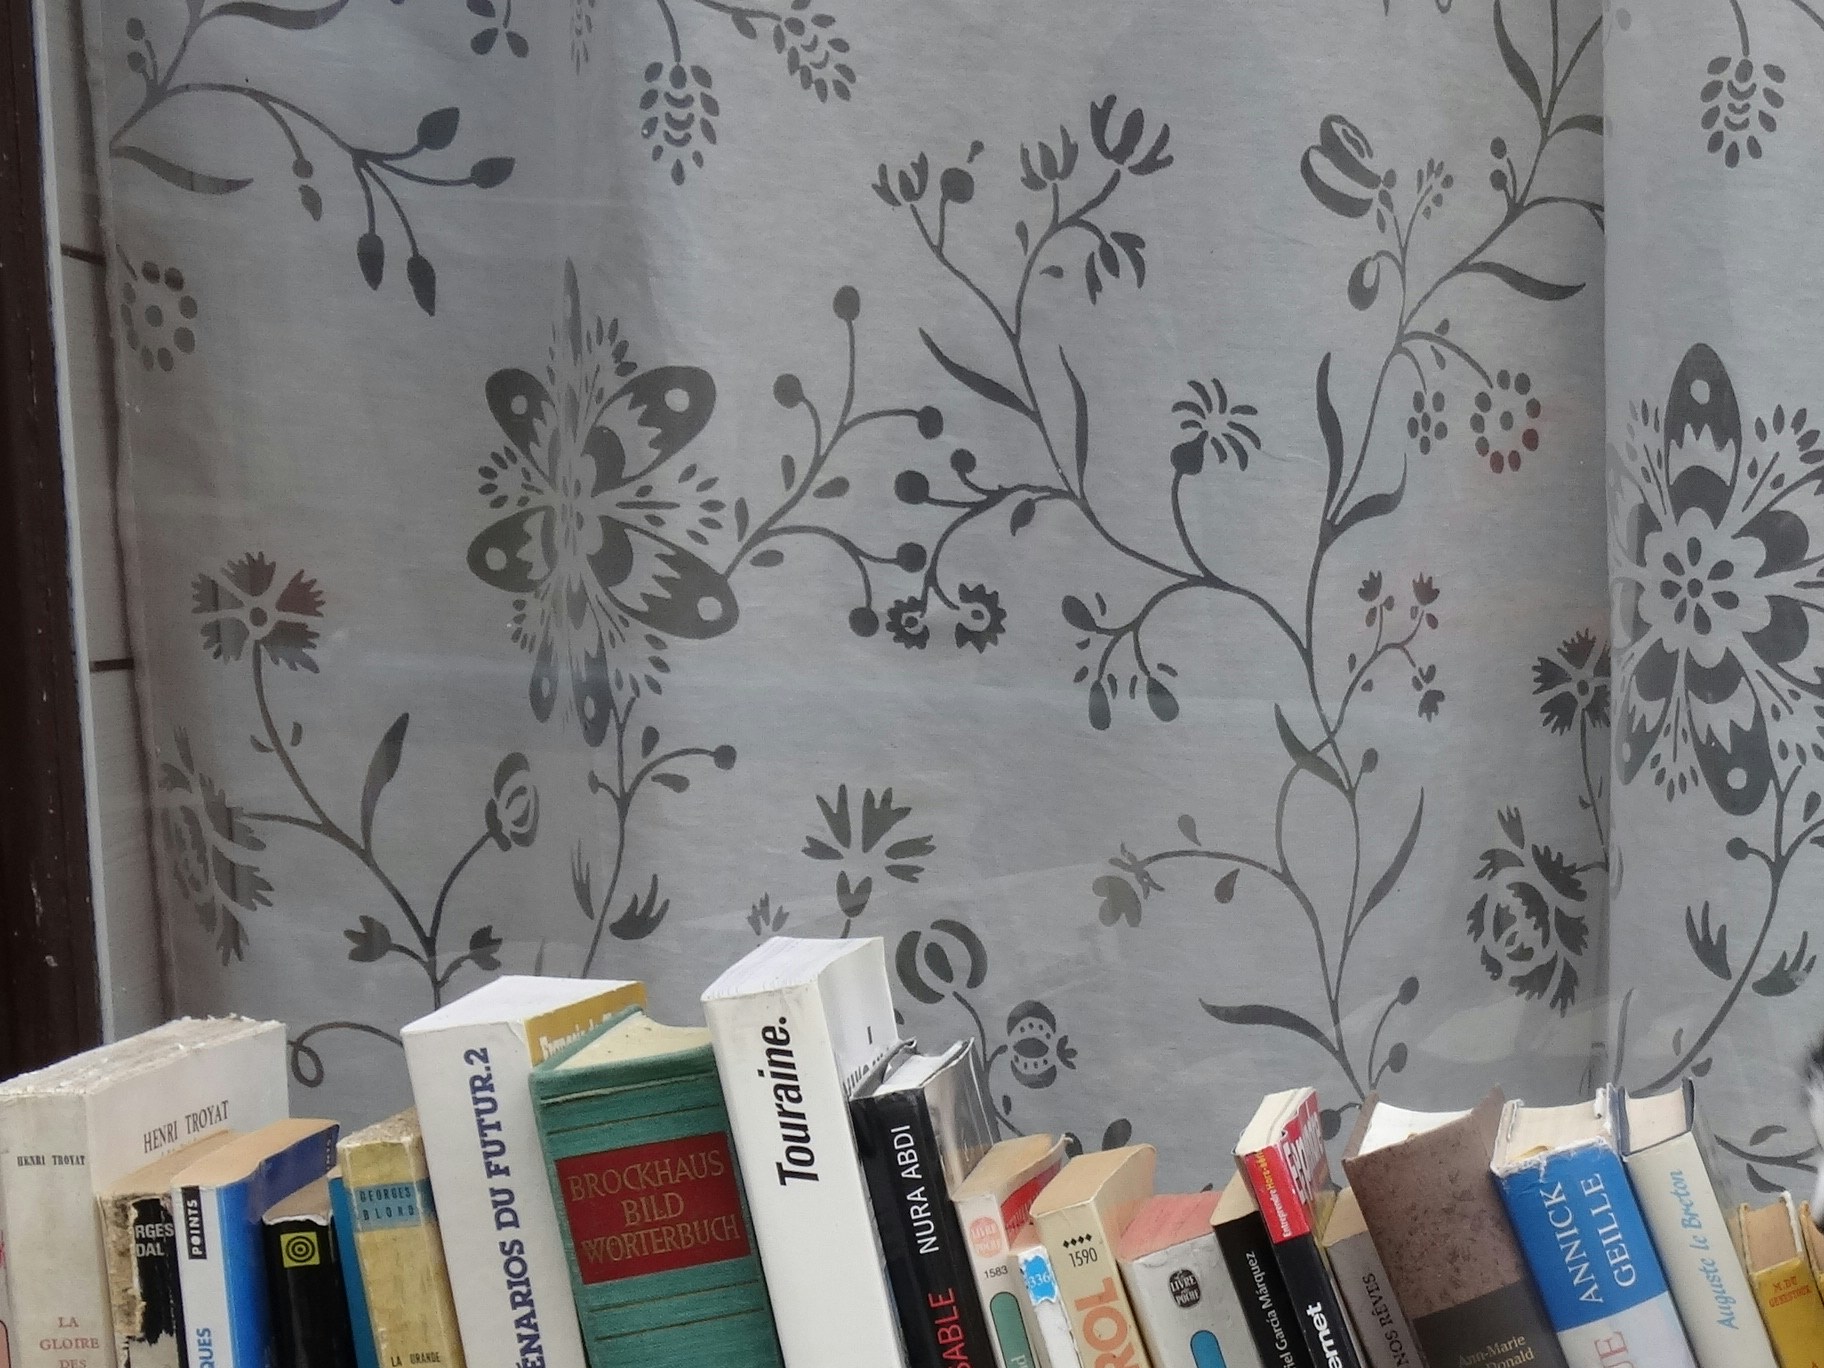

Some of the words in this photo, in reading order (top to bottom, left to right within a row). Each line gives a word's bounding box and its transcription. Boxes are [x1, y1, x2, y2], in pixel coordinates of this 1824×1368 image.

[143, 1120, 178, 1154] HENRI
[184, 1100, 229, 1142] TROYAT
[464, 1047, 510, 1179] FUTUR.2
[758, 1015, 820, 1186] Touraine.
[17, 1155, 46, 1167] HENRI
[52, 1154, 86, 1166] TROYAT
[567, 1150, 724, 1202] BROCKHAUS
[891, 1125, 923, 1179] ABDI
[360, 1186, 411, 1202] GEORGES
[485, 1181, 520, 1231] DU
[622, 1192, 684, 1227] BILD
[906, 1186, 939, 1255] NURA
[1669, 1168, 1701, 1231] Breton
[187, 1199, 203, 1256] POINTS
[1540, 1182, 1603, 1304] ANNICK
[1580, 1173, 1636, 1287] GEILLE
[983, 1265, 1009, 1280] 1583
[1068, 1248, 1098, 1267] 1590
[1246, 1252, 1273, 1308] Márquez
[1362, 1272, 1393, 1328] RÊVES
[1698, 1258, 1740, 1330] Auguste
[39, 1337, 99, 1351] GLOIRE
[57, 1316, 80, 1328] LA
[391, 1353, 403, 1367] LA
[1385, 1330, 1408, 1368] NOS
[1458, 1335, 1527, 1368] Ann-Marie
